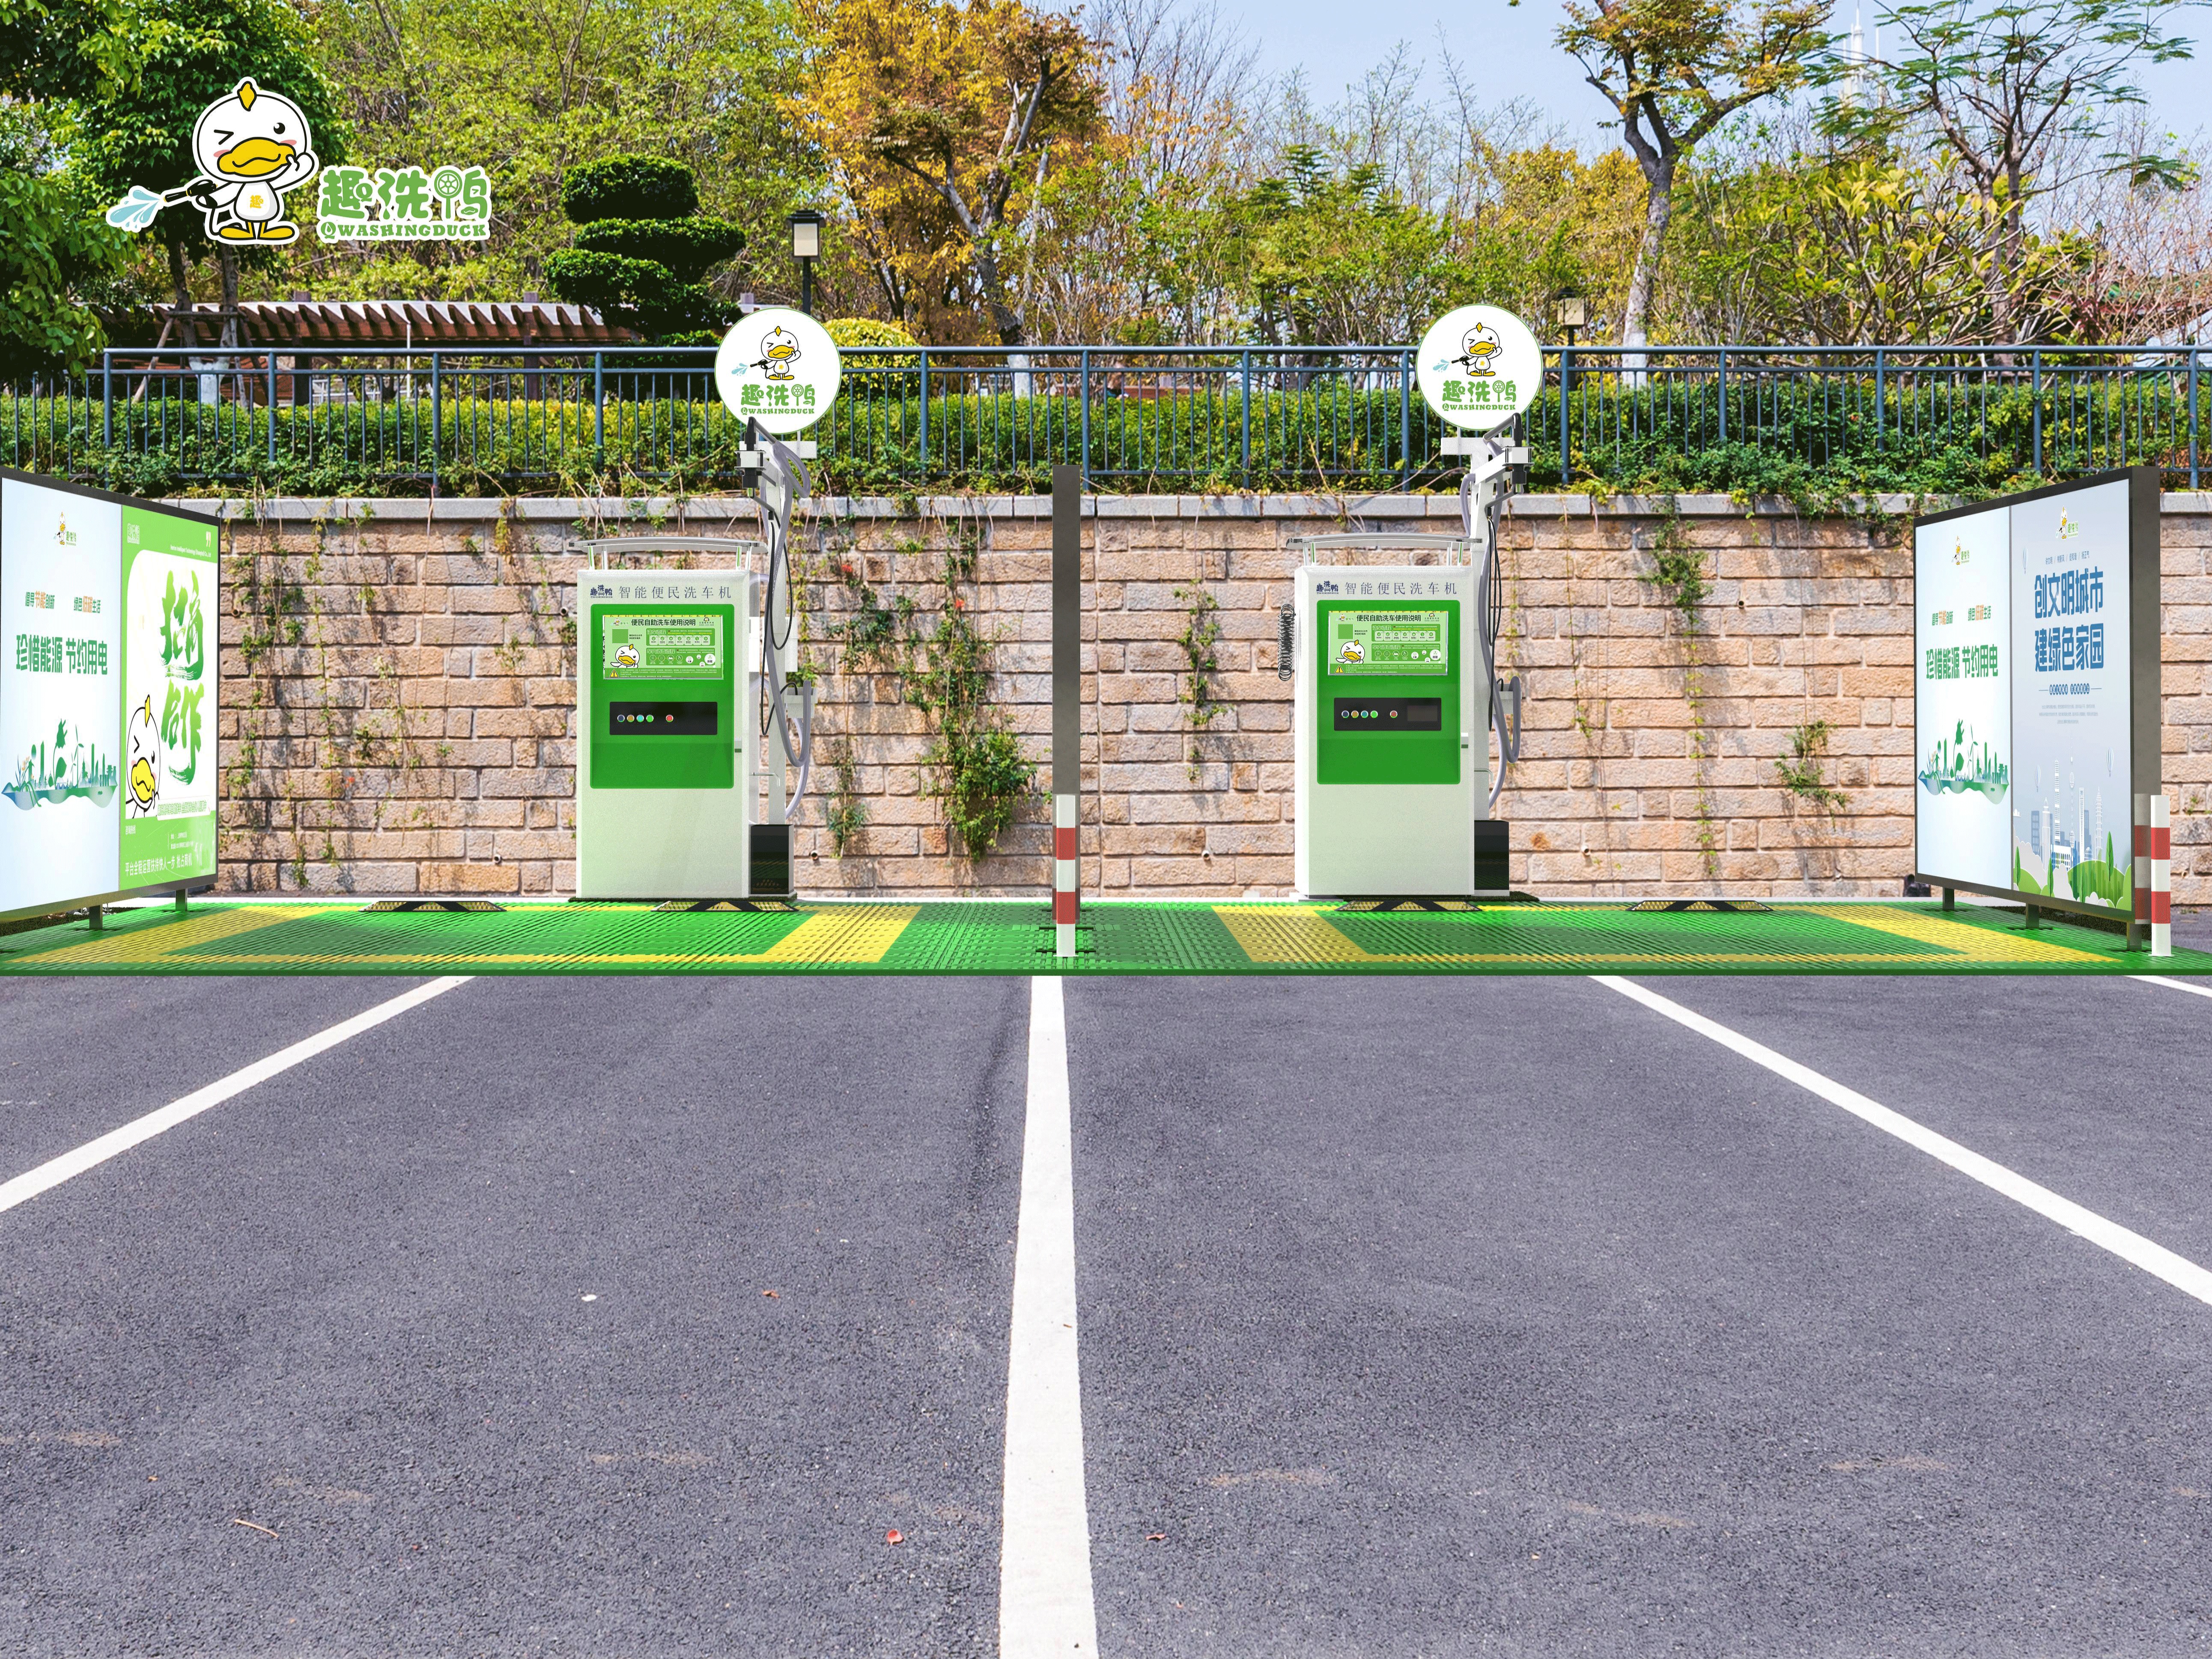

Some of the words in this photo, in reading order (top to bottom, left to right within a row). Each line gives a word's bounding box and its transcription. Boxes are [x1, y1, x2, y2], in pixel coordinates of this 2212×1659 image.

[741, 407, 815, 415] QWASHINGDUCK
[590, 585, 612, 596] 趣洗鸭
[619, 586, 731, 599] 智能便民洗车机
[1317, 580, 1339, 592] 趣洗鸭
[1344, 582, 1457, 595] 智能便民洗车机
[2035, 566, 2103, 618] 创文明城市
[25, 591, 55, 609] 倡导节能创新
[74, 596, 101, 613] 绿色低碳生活
[1932, 610, 1953, 626] 倡导节能创新
[1968, 605, 1991, 621] 绿色低碳生活
[16, 634, 63, 673] 珍惜能源
[66, 637, 107, 674] 节约用电
[2035, 623, 2104, 672] 建绿色家园
[1926, 647, 1959, 680] 珍惜能源
[1962, 644, 1998, 678] 节约用电
